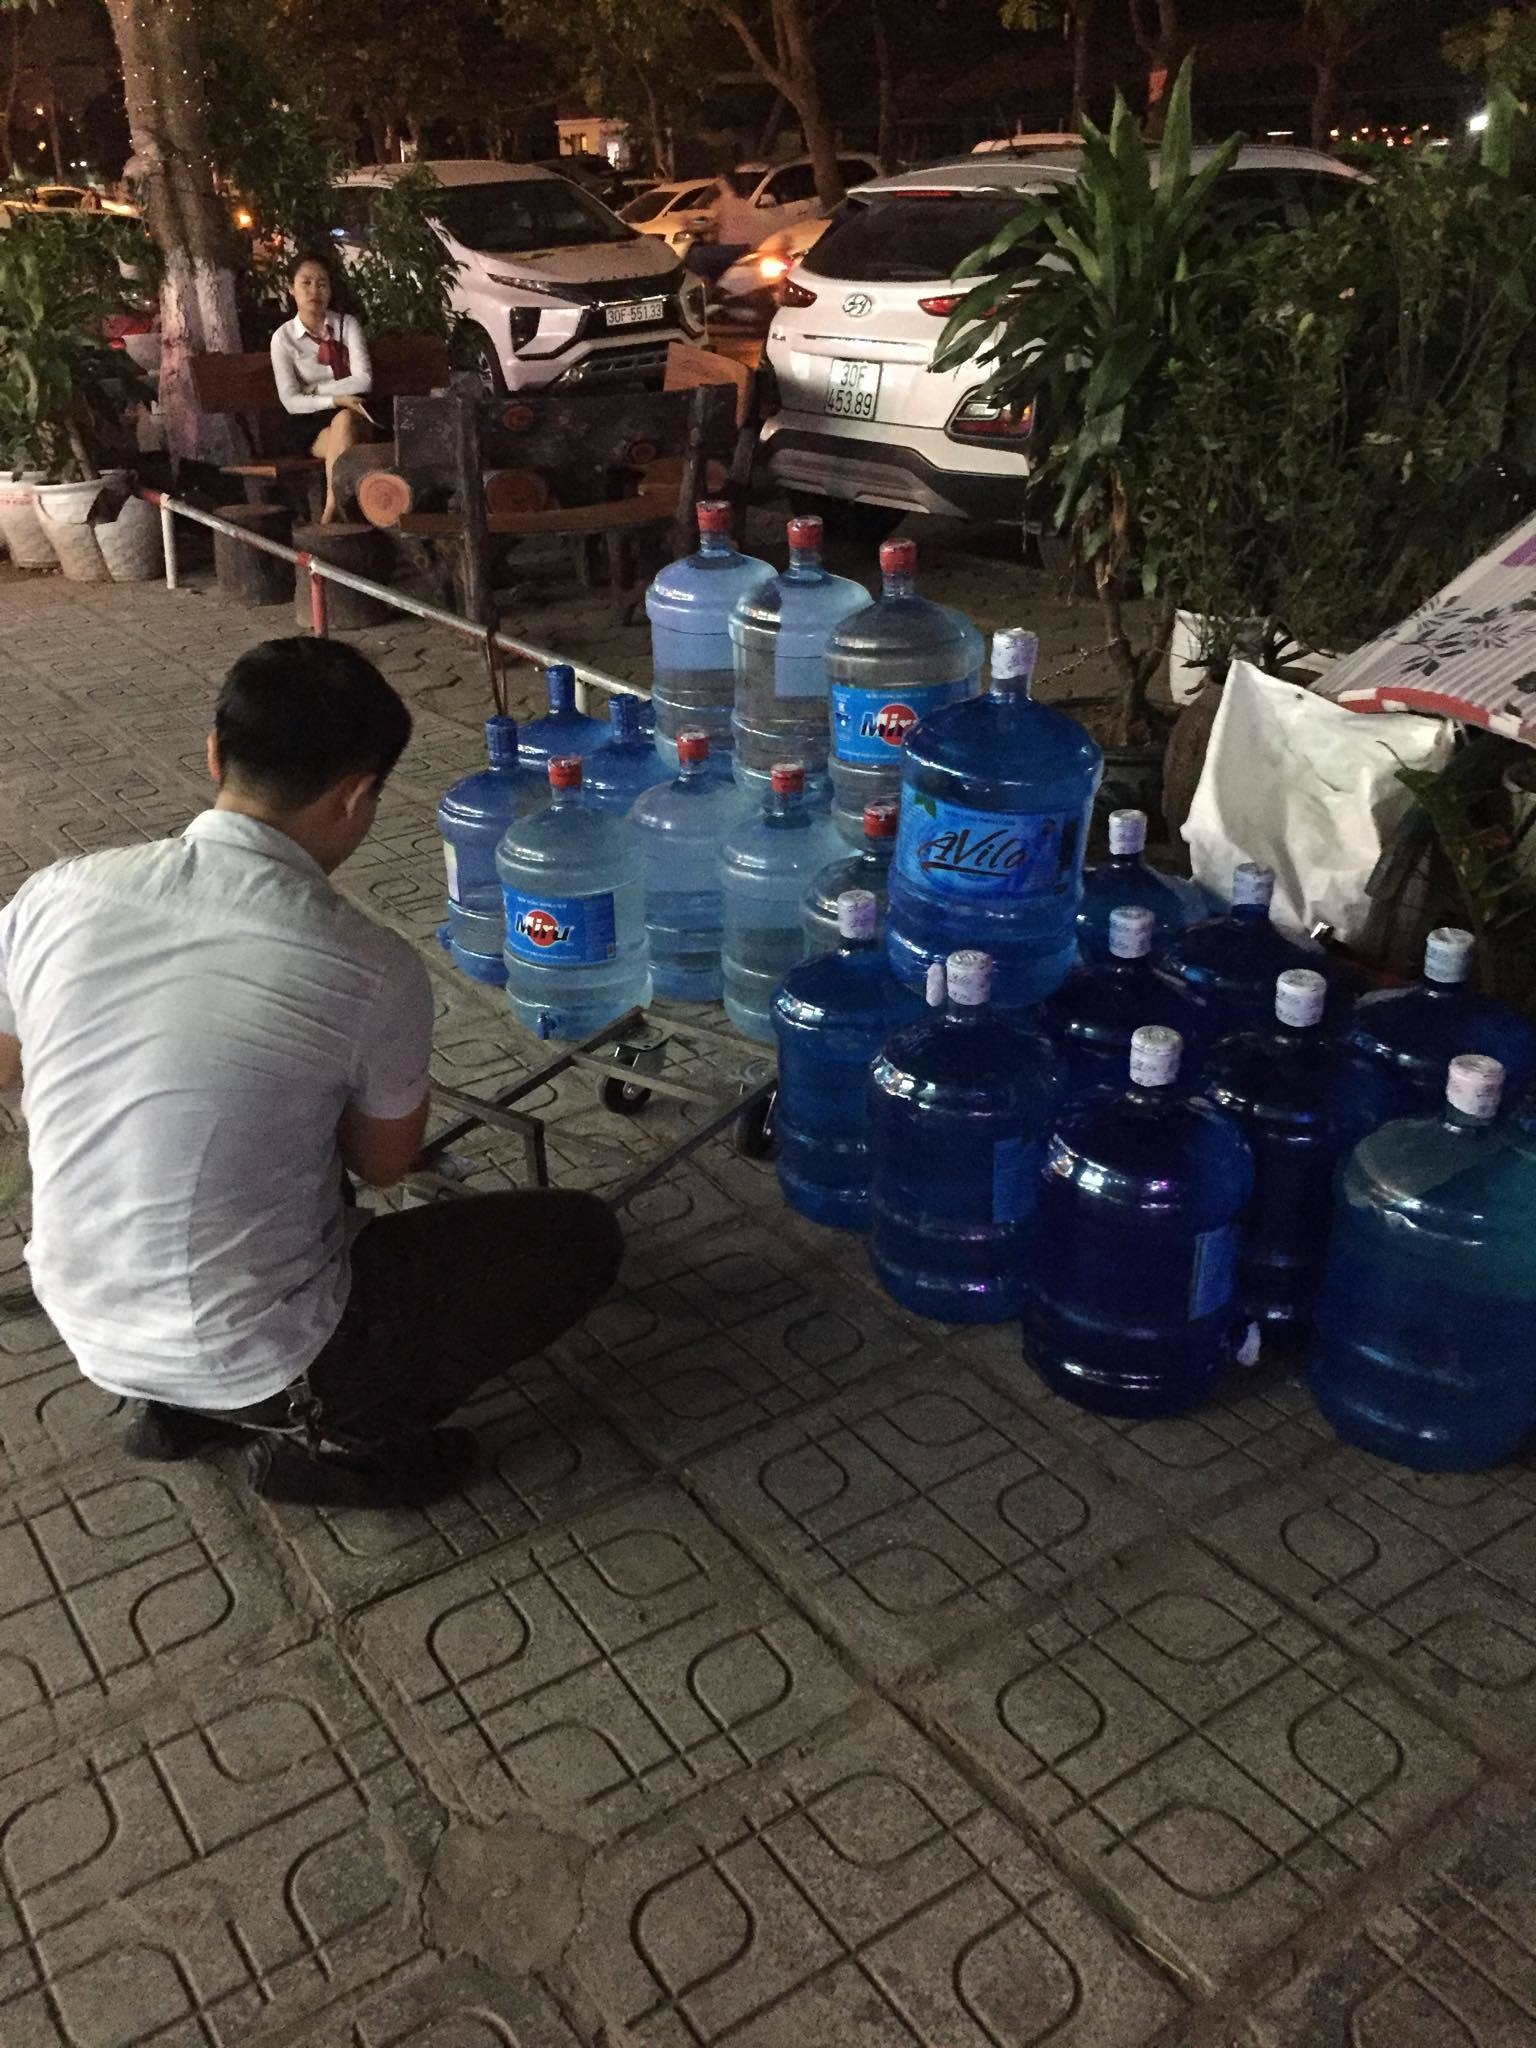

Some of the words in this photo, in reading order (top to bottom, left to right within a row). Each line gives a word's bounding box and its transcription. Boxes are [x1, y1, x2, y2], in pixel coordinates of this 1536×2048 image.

[840, 365, 868, 388] 30F
[860, 711, 920, 737] Mir
[514, 911, 575, 942] Miru
